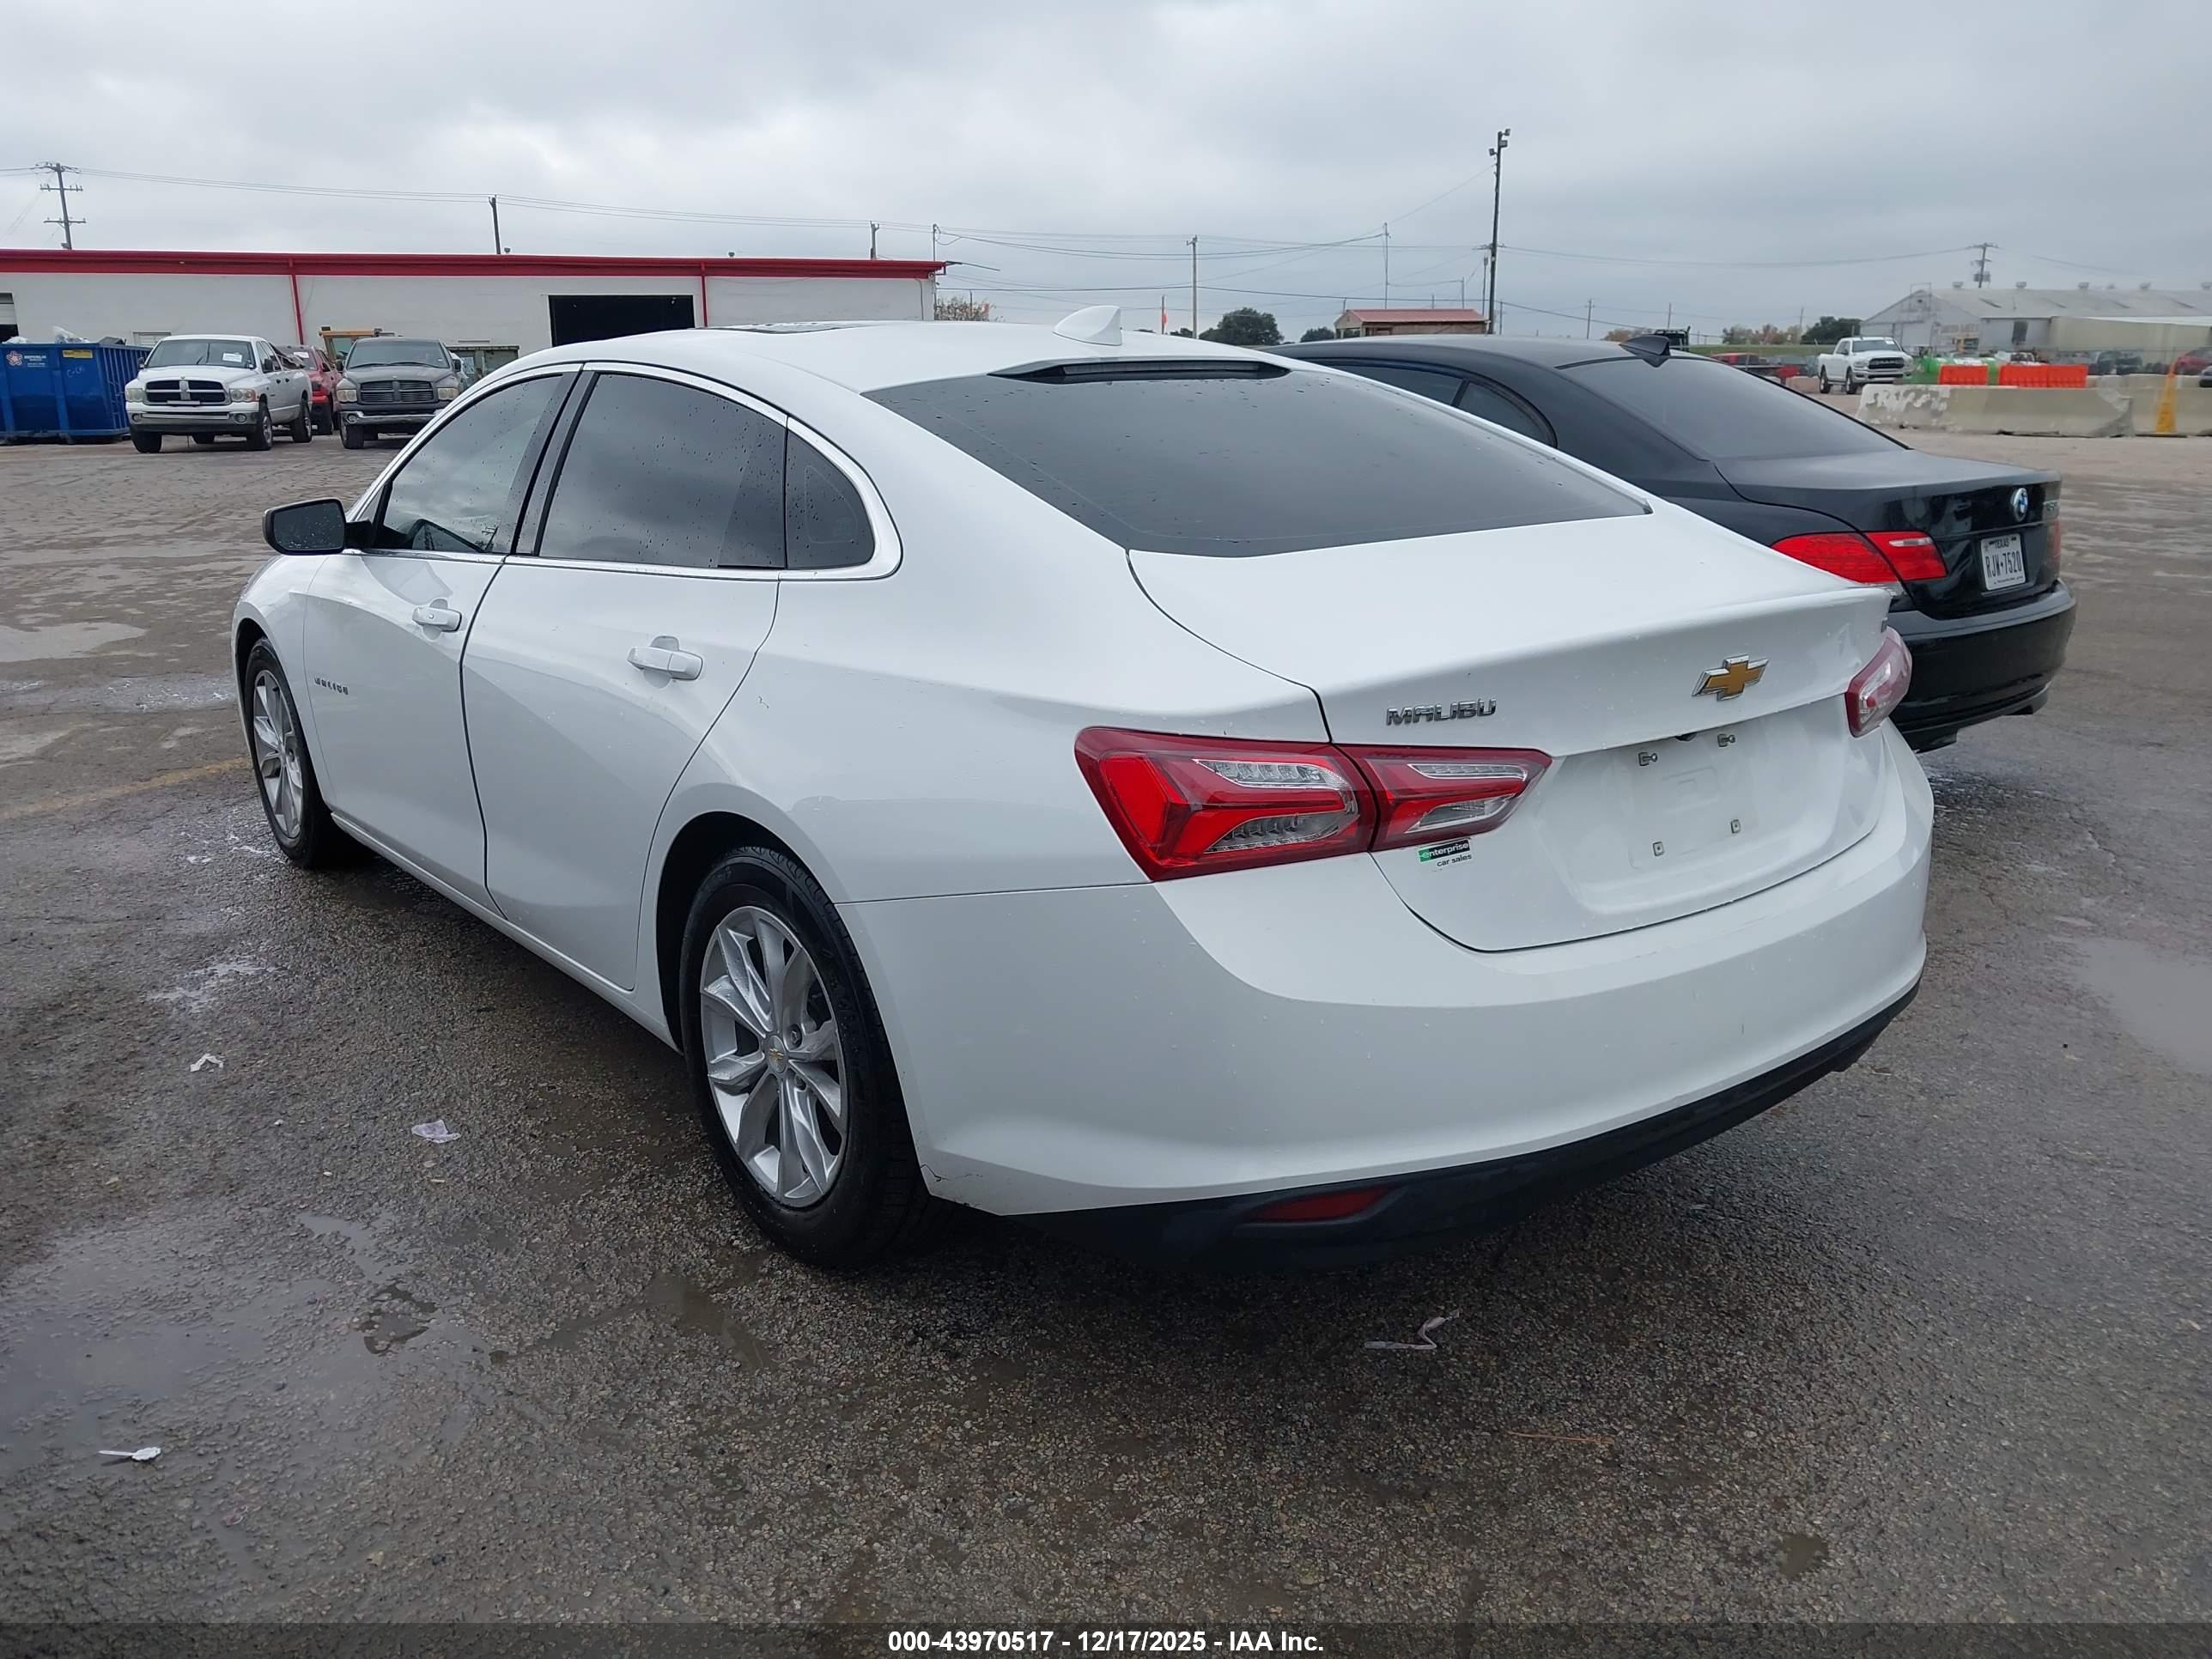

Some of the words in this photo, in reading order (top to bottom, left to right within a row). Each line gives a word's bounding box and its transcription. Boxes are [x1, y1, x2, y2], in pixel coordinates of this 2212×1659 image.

[1386, 698, 1497, 726] MALIBU
[1420, 843, 1469, 858] enterprise
[1437, 859, 1450, 867] car
[1451, 854, 1472, 864] sales
